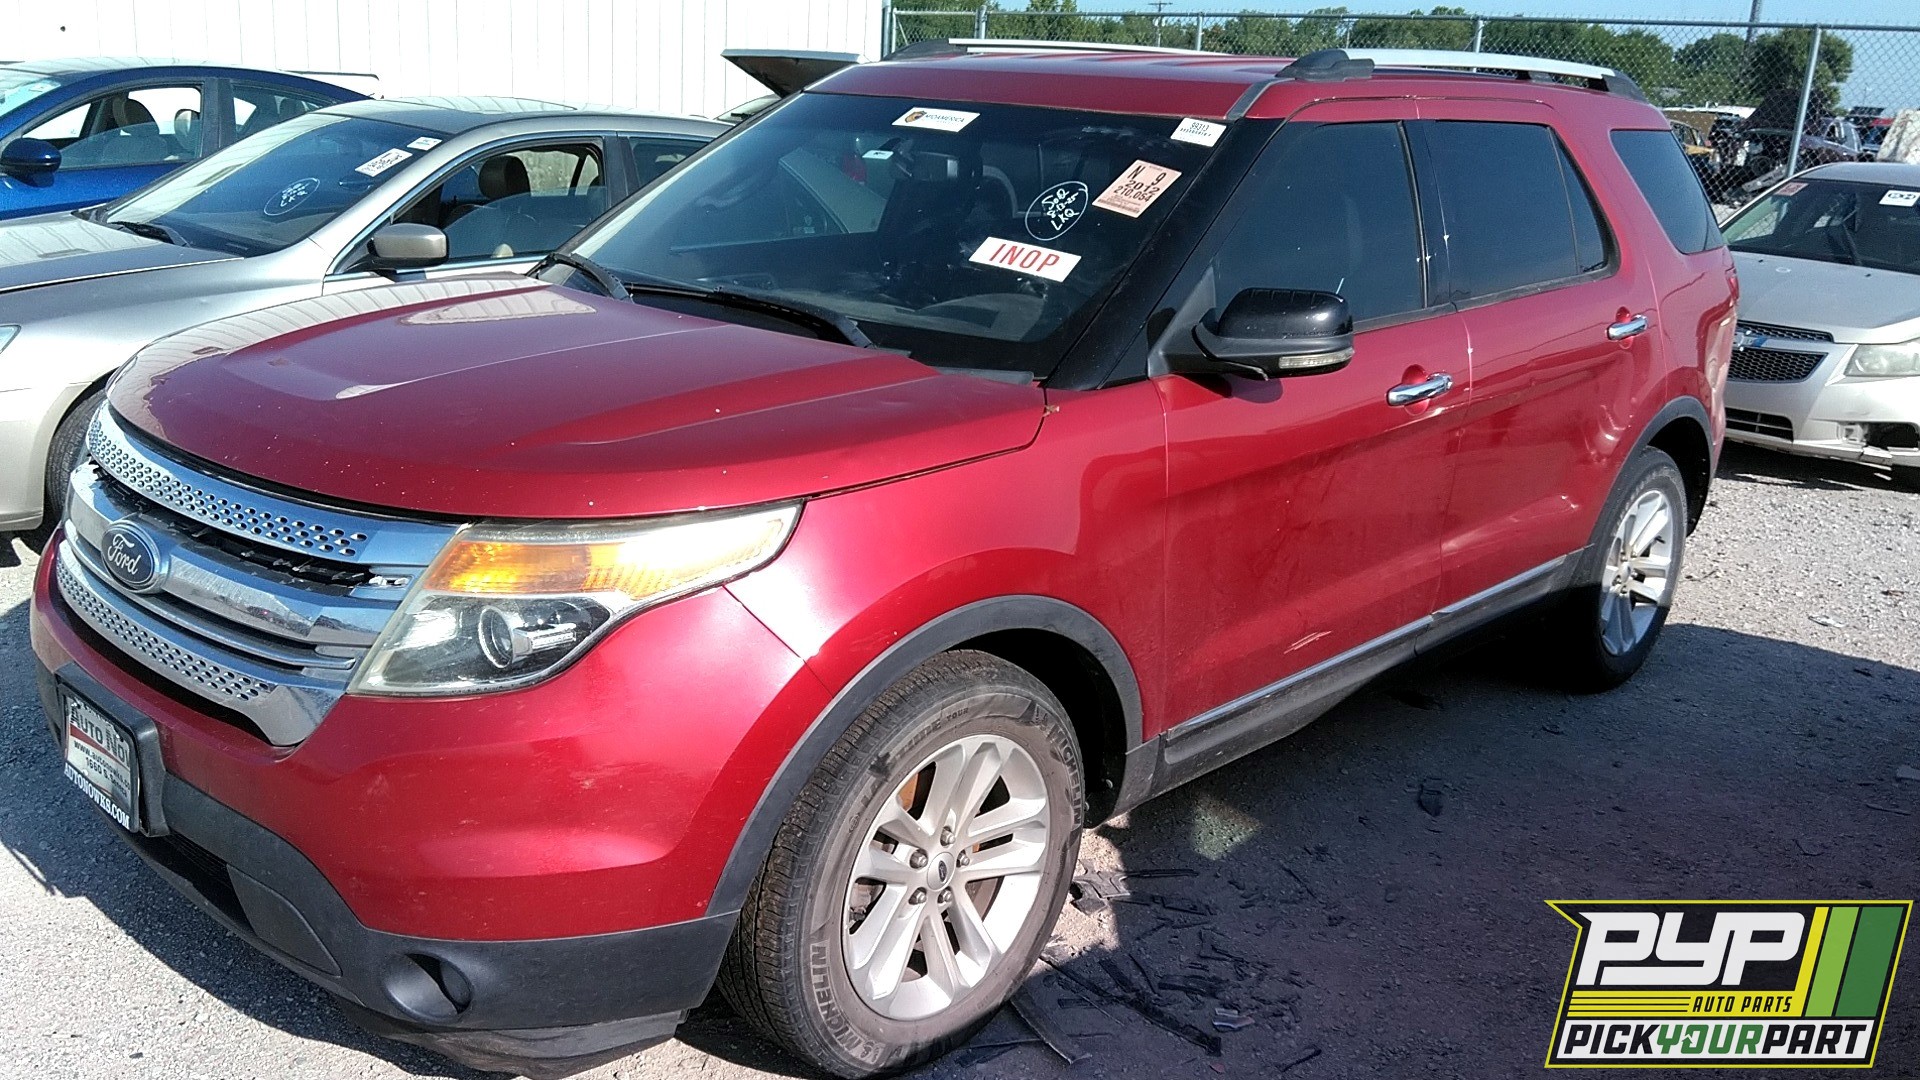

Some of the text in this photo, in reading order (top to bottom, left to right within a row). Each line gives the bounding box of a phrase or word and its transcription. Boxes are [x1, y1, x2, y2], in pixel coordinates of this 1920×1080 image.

[1125, 180, 1160, 195] 2012
[1127, 165, 1146, 180] N
[1151, 172, 1167, 186] 9
[1113, 185, 1156, 203] 210,054
[1051, 208, 1080, 231] LKQ
[989, 243, 1061, 273] INOP
[107, 533, 142, 576] Ford
[70, 707, 104, 745] AUTO
[1046, 722, 1082, 825] MICHELIN
[64, 762, 130, 830] AUTONOWKS.COM
[810, 944, 862, 1052] MICHELIN
